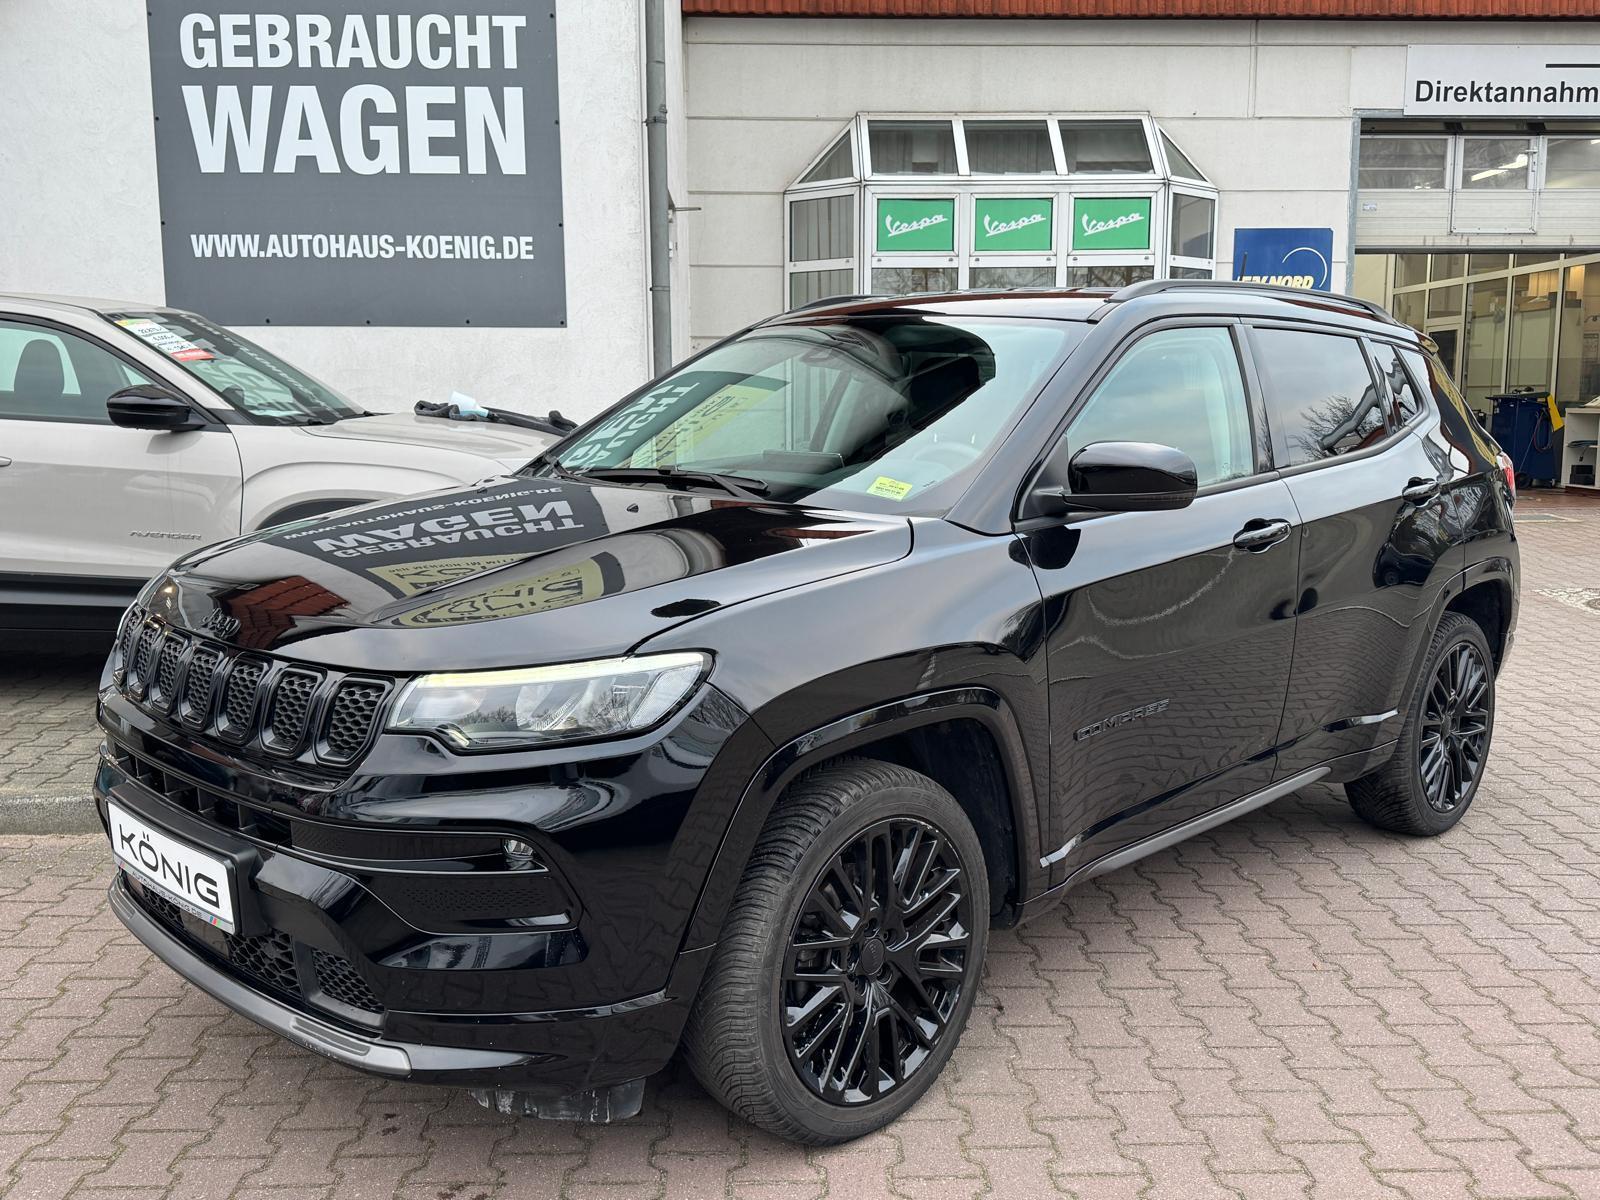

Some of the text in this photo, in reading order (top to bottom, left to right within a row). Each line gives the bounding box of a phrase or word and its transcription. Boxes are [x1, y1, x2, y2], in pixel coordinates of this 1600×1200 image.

[179, 13, 527, 70] GEBRAUCHT
[1415, 79, 1600, 103] Direktannahm
[181, 84, 527, 175] WAGEN
[885, 214, 949, 237] Vespa
[983, 213, 1047, 237] Vespa
[1081, 212, 1145, 236] Vespa
[190, 233, 535, 260] WWW.AUTOHAUS-KOENIG.DE
[129, 530, 202, 540] AVENGER
[1074, 698, 1169, 741] COMPASS
[118, 823, 220, 909] KÖNIG
